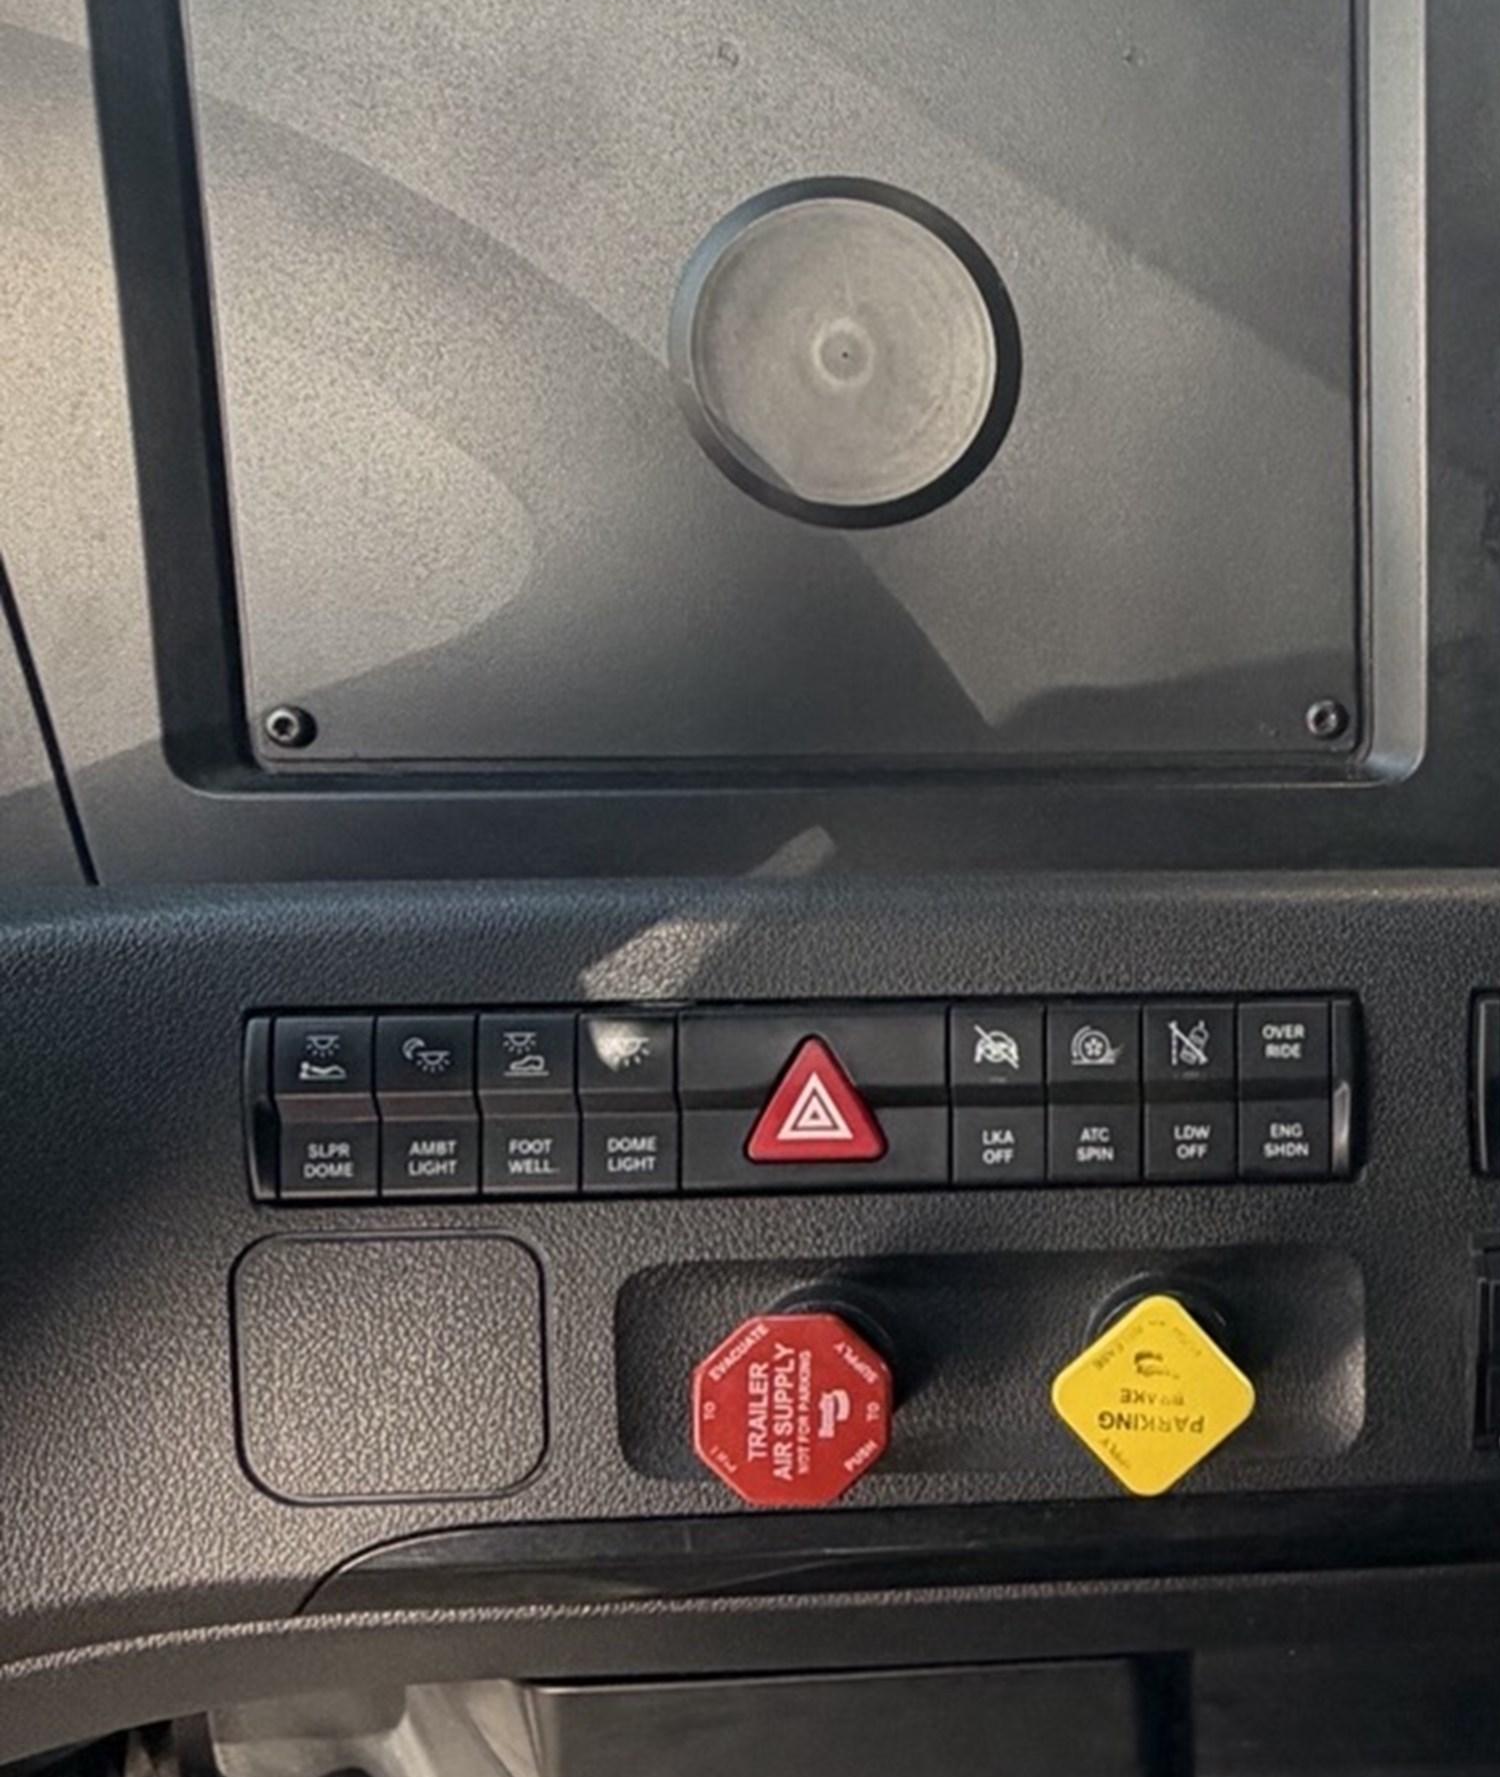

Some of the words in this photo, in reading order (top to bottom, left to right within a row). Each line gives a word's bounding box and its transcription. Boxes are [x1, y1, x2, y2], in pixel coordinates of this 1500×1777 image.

[1262, 1024, 1304, 1039] OVER
[1266, 1043, 1300, 1058] RIDE
[983, 1130, 1014, 1145] LKA
[1080, 1127, 1109, 1142] ATC
[1174, 1125, 1210, 1140] LDW
[1270, 1123, 1303, 1138] ENG
[308, 1143, 350, 1158] SLPR
[409, 1140, 456, 1155] AMBT
[509, 1139, 552, 1154] FOOT
[607, 1137, 656, 1152] DOME
[1177, 1144, 1206, 1159] OFF
[1264, 1142, 1309, 1157] SHDN
[983, 1149, 1013, 1164] OFF
[1077, 1147, 1113, 1161] SPIN
[304, 1162, 353, 1178] DOME
[409, 1160, 457, 1176] LIGHT
[508, 1159, 554, 1174] WELL
[608, 1156, 655, 1172] LIGHT
[709, 1323, 769, 1381] EVACUATE
[834, 1342, 878, 1384] SUPPLY
[798, 1350, 812, 1411] PARKING
[773, 1343, 794, 1435] SUPPLY
[704, 1401, 716, 1420] TO
[748, 1362, 768, 1462] TRAILER
[866, 1402, 880, 1422] TO
[798, 1415, 810, 1443] FOR
[1098, 1411, 1205, 1434] PARKING
[773, 1441, 793, 1481] AIR
[798, 1446, 811, 1474] NOT
[844, 1440, 878, 1471] PUSH
